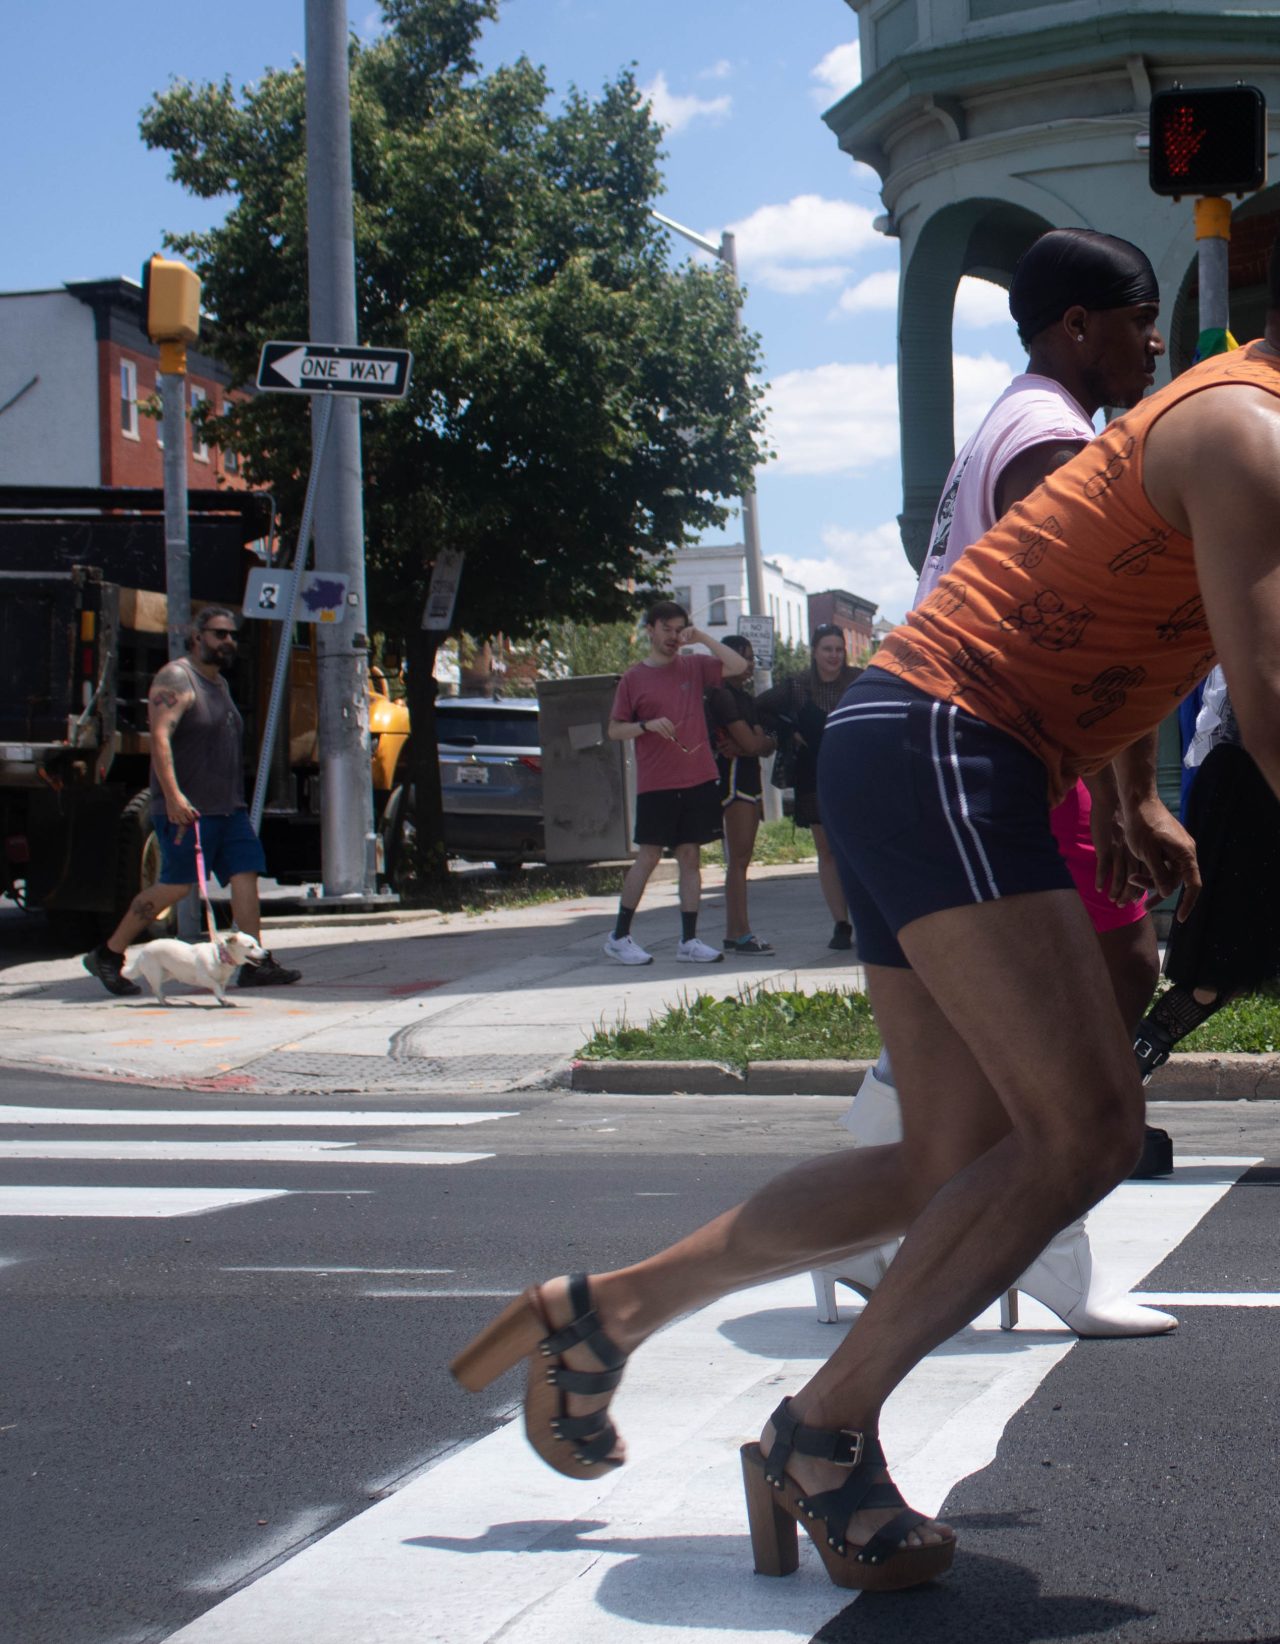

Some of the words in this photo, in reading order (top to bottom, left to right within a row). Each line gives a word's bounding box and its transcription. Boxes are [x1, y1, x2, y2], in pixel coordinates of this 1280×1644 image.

[301, 358, 340, 378] ONE
[350, 361, 391, 381] WAY
[751, 623, 762, 631] NO
